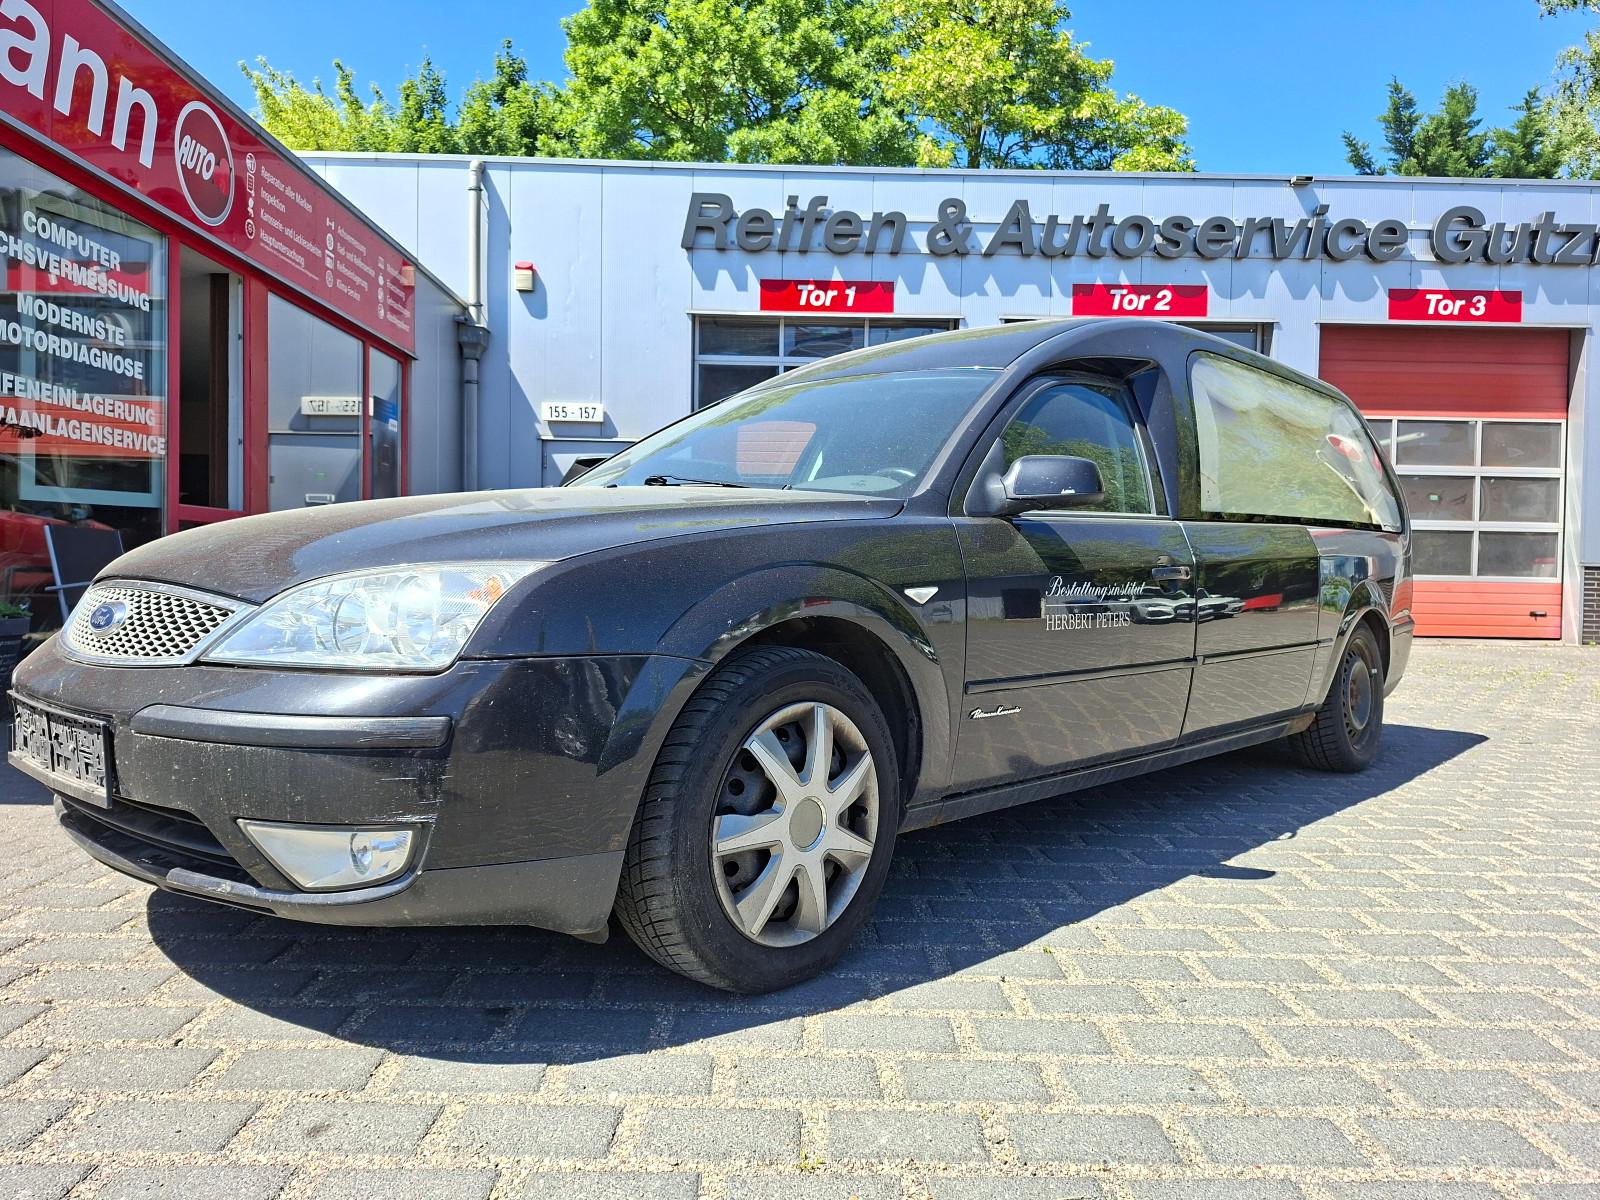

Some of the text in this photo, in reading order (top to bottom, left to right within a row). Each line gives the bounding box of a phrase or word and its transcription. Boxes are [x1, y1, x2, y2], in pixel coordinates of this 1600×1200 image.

[180, 135, 216, 180] AUTO
[261, 187, 286, 213] Inspektion
[23, 211, 121, 272] COMPUTER
[681, 192, 1600, 266] Reifen & Autoservice Gutz
[797, 284, 857, 307] Tor 1
[1110, 289, 1173, 311] Tor 2
[1425, 293, 1487, 316] Tor 3
[17, 292, 126, 346] MODERNSTE
[0, 371, 156, 426] FENEINLAGERUNG
[549, 405, 568, 419] 155
[579, 406, 597, 420] 157
[1045, 575, 1146, 603] Bestattungsinstitut
[1046, 611, 1131, 631] HERBERT PETERS
